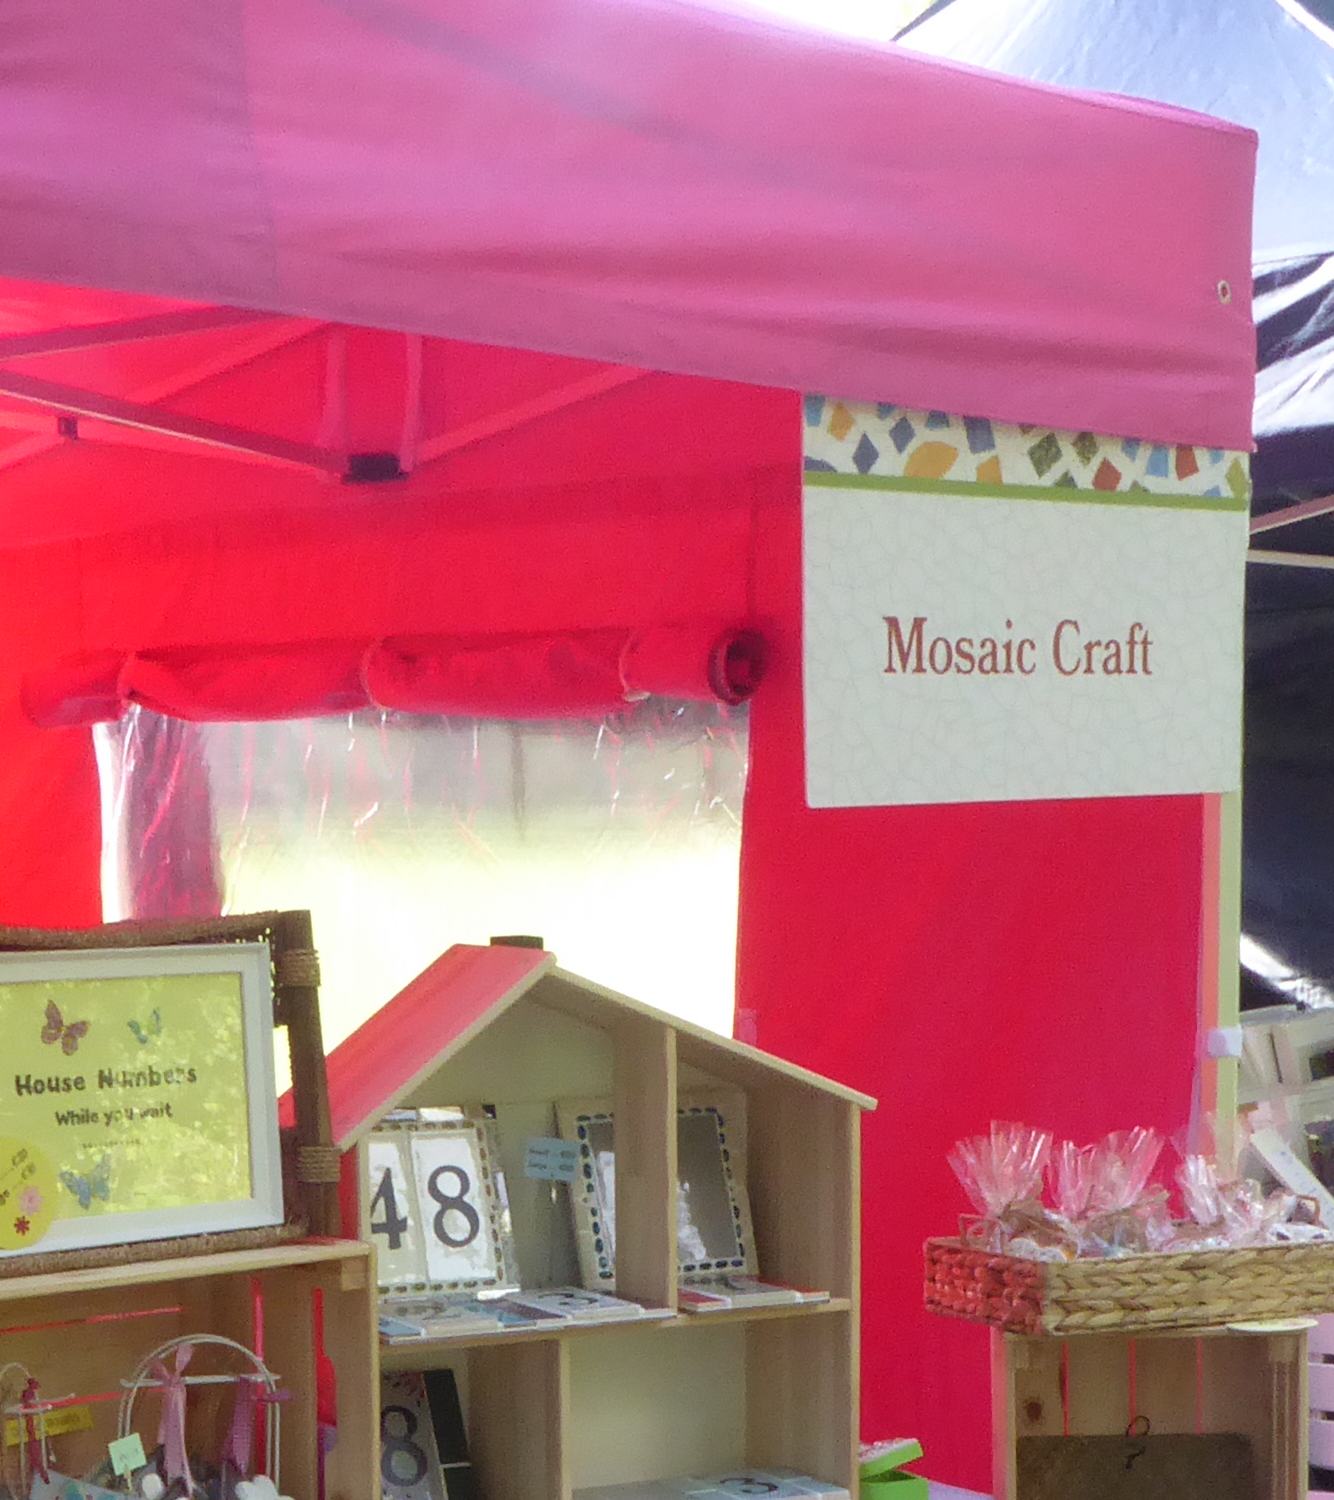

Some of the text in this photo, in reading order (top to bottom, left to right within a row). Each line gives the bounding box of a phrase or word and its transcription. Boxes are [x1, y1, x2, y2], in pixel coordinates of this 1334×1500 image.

[882, 615, 1154, 676] Mosaic Craft
[14, 1064, 198, 1097] House Numbers
[55, 1102, 173, 1127] While you wait
[369, 1165, 481, 1250] 48
[380, 1405, 428, 1487] 8
